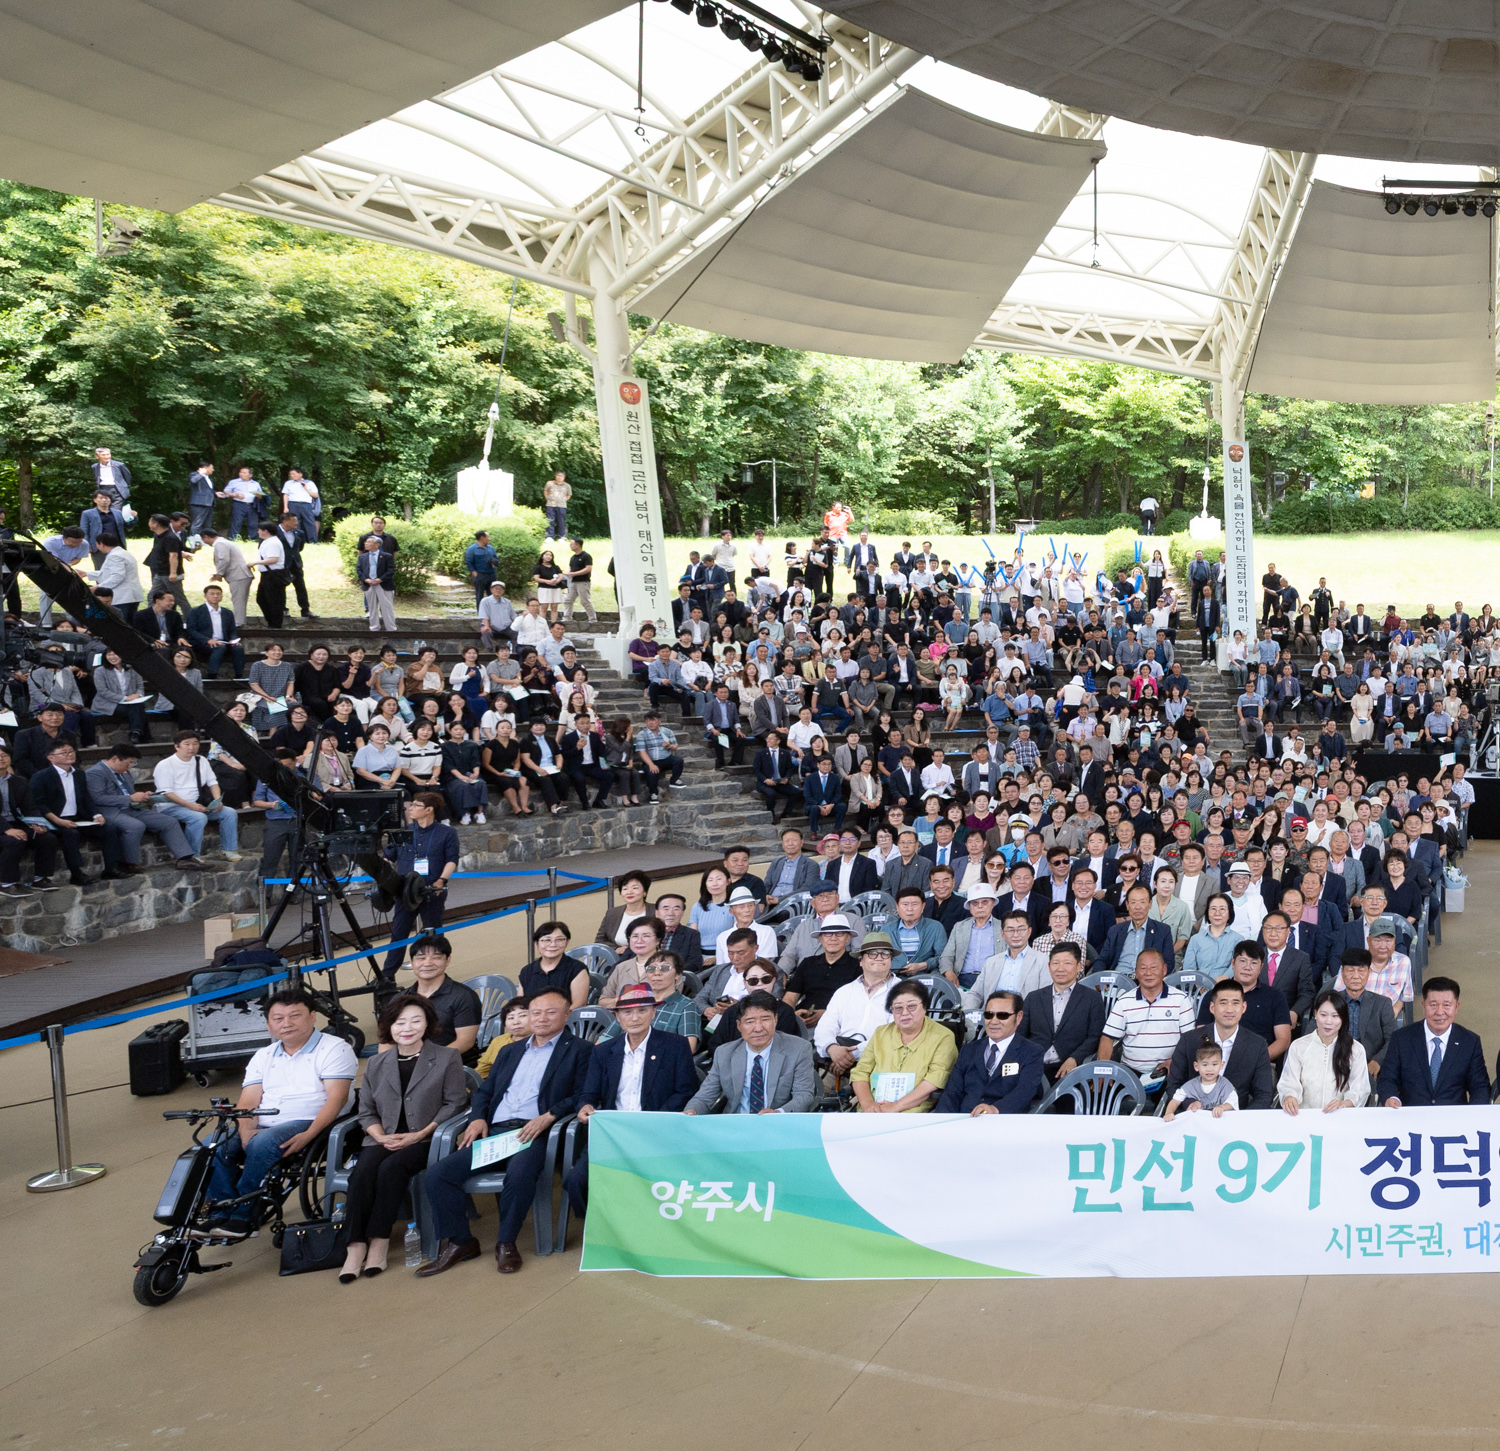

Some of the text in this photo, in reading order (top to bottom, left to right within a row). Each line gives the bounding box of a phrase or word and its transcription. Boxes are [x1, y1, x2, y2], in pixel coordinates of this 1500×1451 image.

[625, 410, 641, 436] 원산
[634, 499, 650, 525] 넘어
[637, 529, 655, 567] 태산이
[643, 572, 658, 609] 출렁!
[1065, 1134, 1197, 1214] 민선
[1215, 1133, 1324, 1211] 9기
[650, 1179, 775, 1223] 양주시
[1324, 1221, 1452, 1259] 시민주권,
